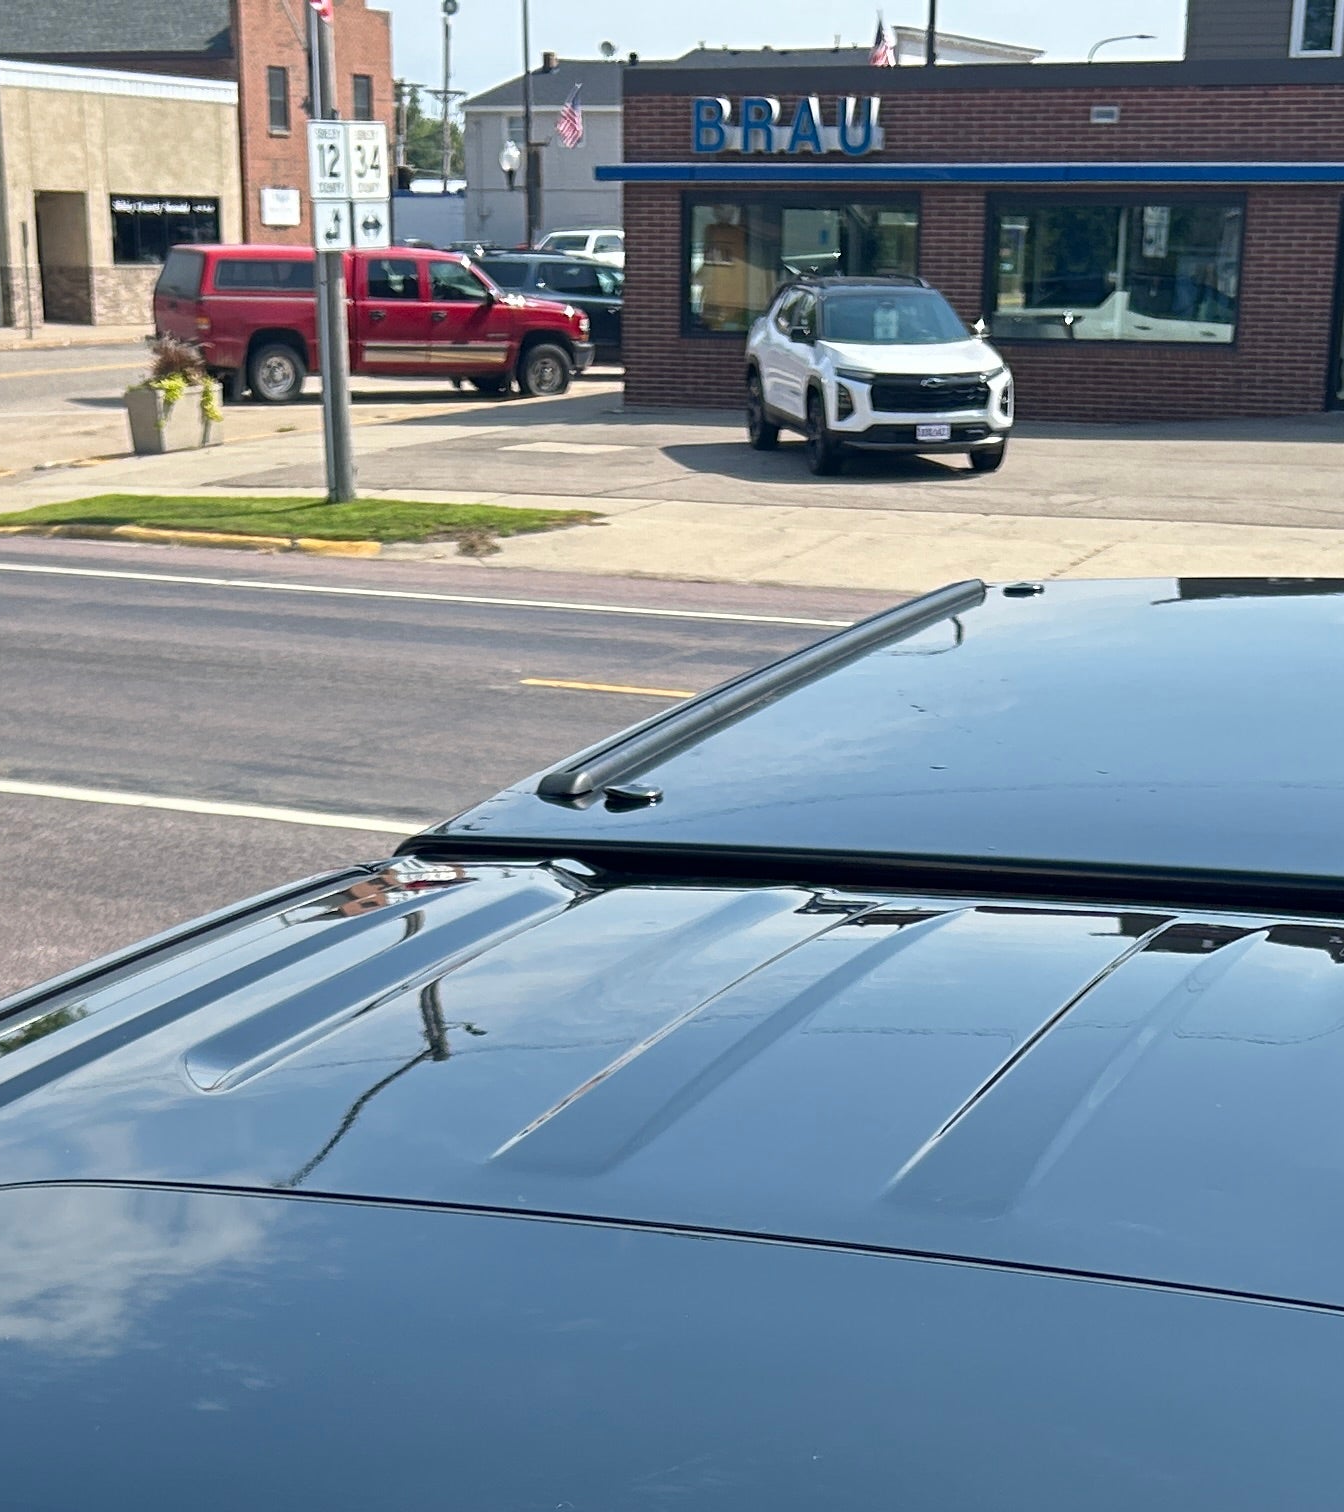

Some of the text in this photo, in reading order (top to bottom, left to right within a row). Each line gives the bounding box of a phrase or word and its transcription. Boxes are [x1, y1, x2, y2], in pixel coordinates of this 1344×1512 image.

[693, 97, 876, 155] BRAU
[317, 144, 340, 178] 12
[355, 144, 381, 178] 34
